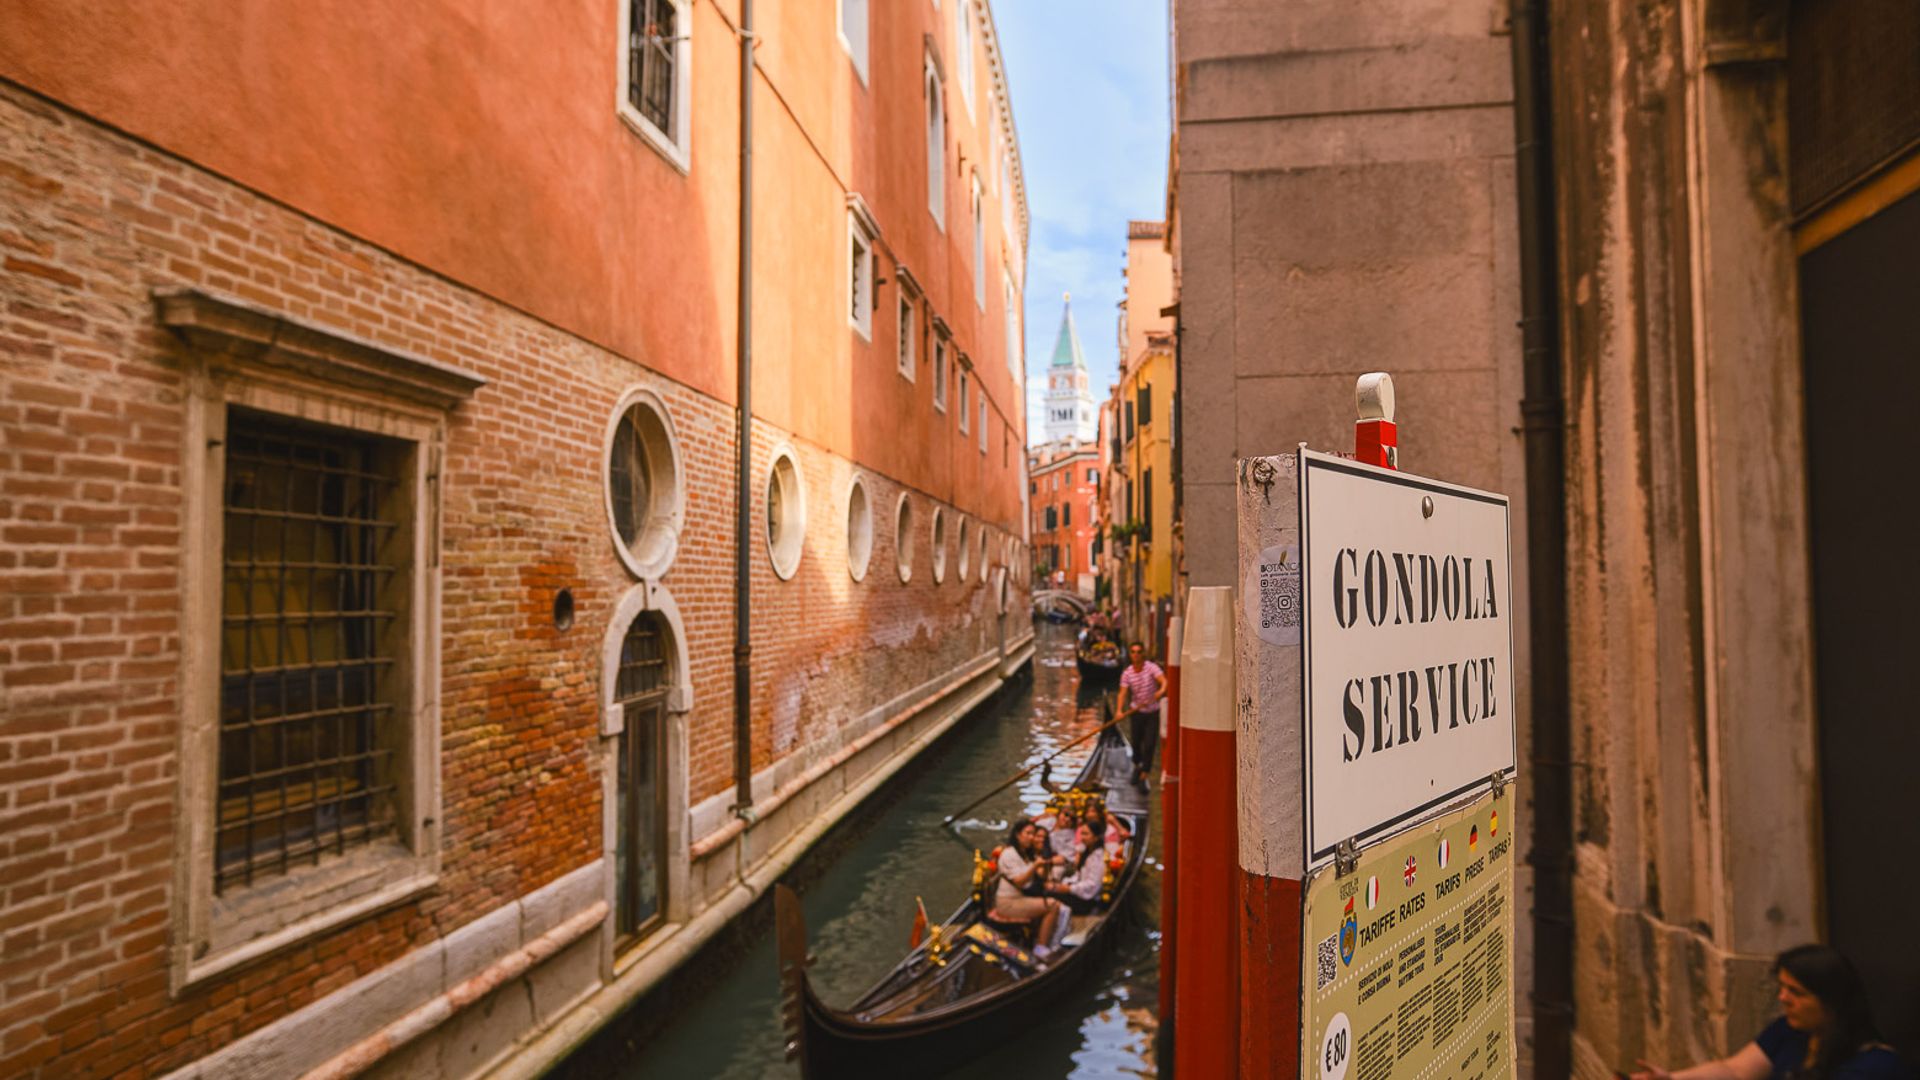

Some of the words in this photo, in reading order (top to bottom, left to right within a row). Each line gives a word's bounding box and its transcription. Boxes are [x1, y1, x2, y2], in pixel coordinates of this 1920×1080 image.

[1333, 548, 1498, 629] GONDOLA
[1342, 657, 1497, 763] SERVICE
[1360, 909, 1396, 948] TARIFFE
[1400, 892, 1425, 922] RATES
[1435, 872, 1460, 900] TARIFS
[1465, 856, 1485, 883] PREISE
